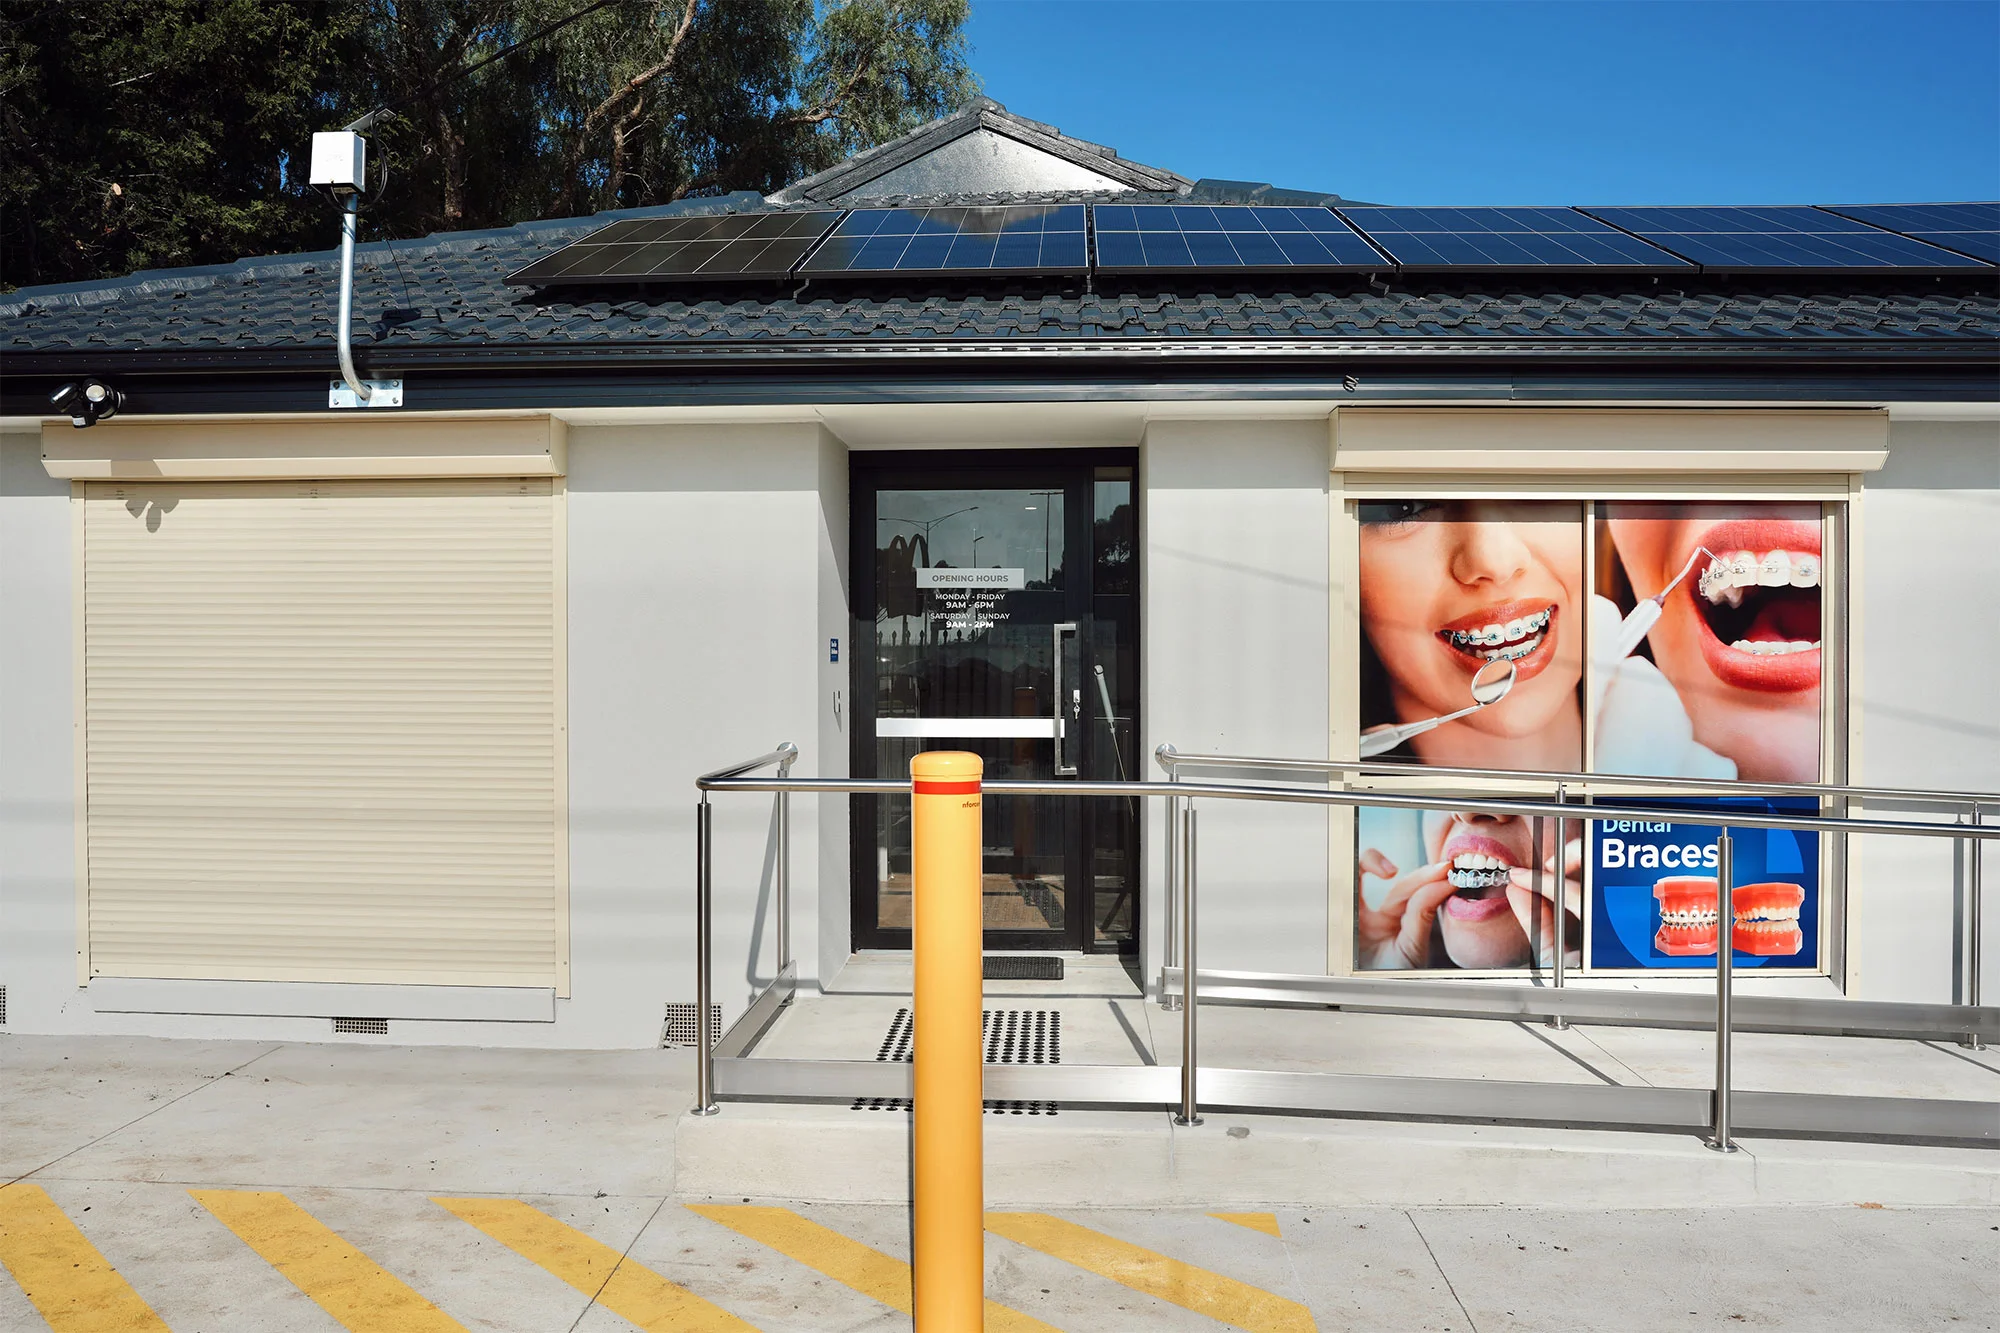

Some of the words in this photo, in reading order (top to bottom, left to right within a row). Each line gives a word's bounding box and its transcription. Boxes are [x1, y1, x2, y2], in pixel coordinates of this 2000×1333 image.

[946, 601, 966, 609] 9AM
[974, 601, 994, 609] 6PM
[1602, 838, 1718, 868] Braces
